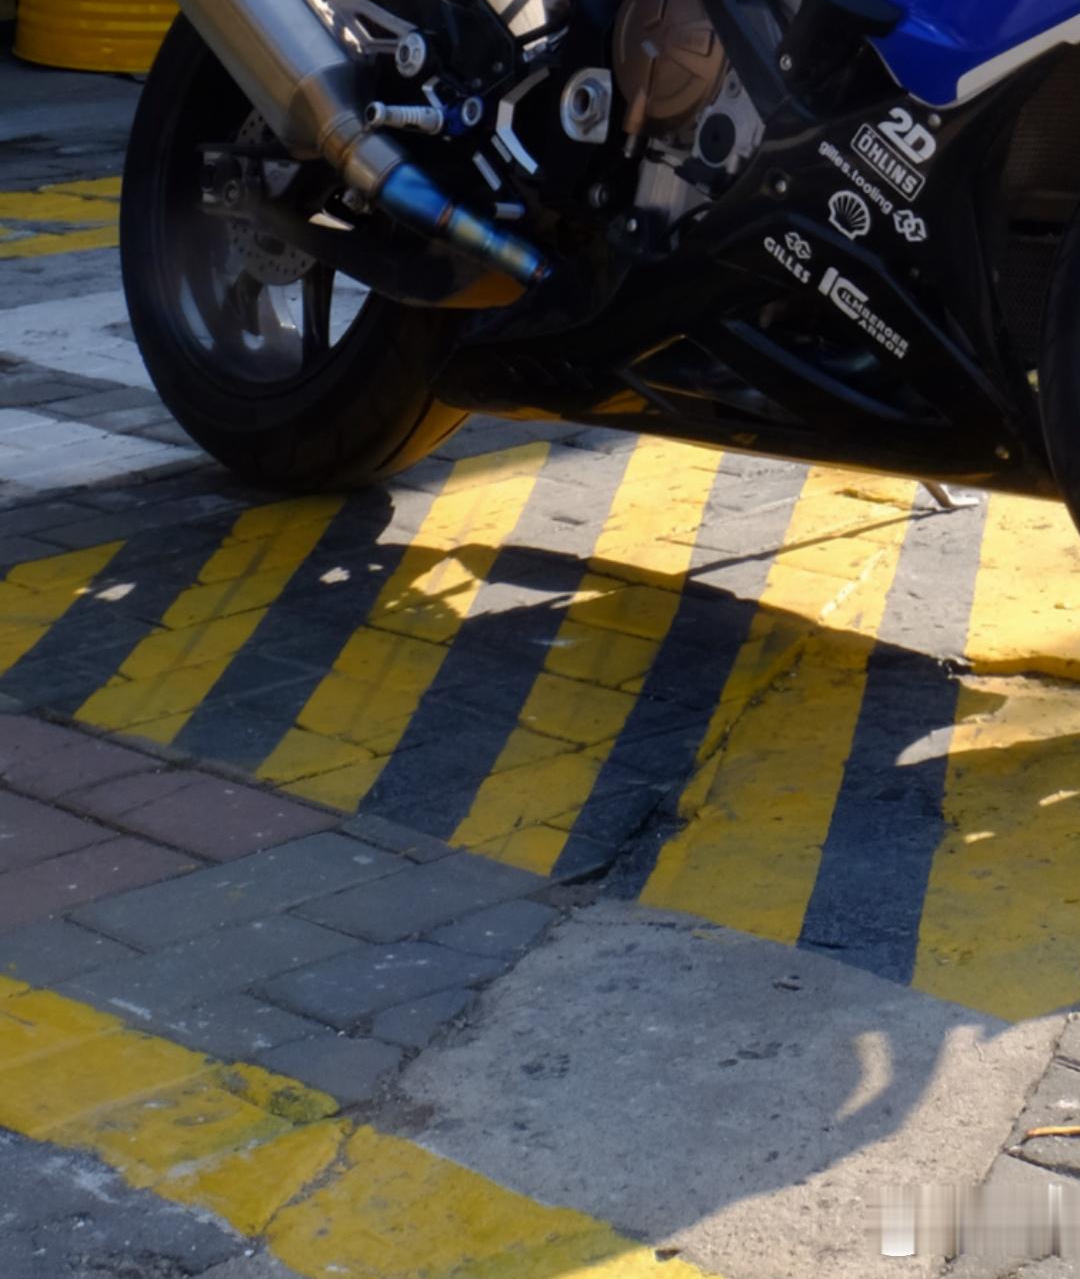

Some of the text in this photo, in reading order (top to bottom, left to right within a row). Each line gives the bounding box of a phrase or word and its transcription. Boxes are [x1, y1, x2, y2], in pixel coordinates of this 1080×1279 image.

[857, 129, 918, 194] ÖHLINS
[877, 107, 937, 164] 2D
[763, 237, 812, 284] GILLES
